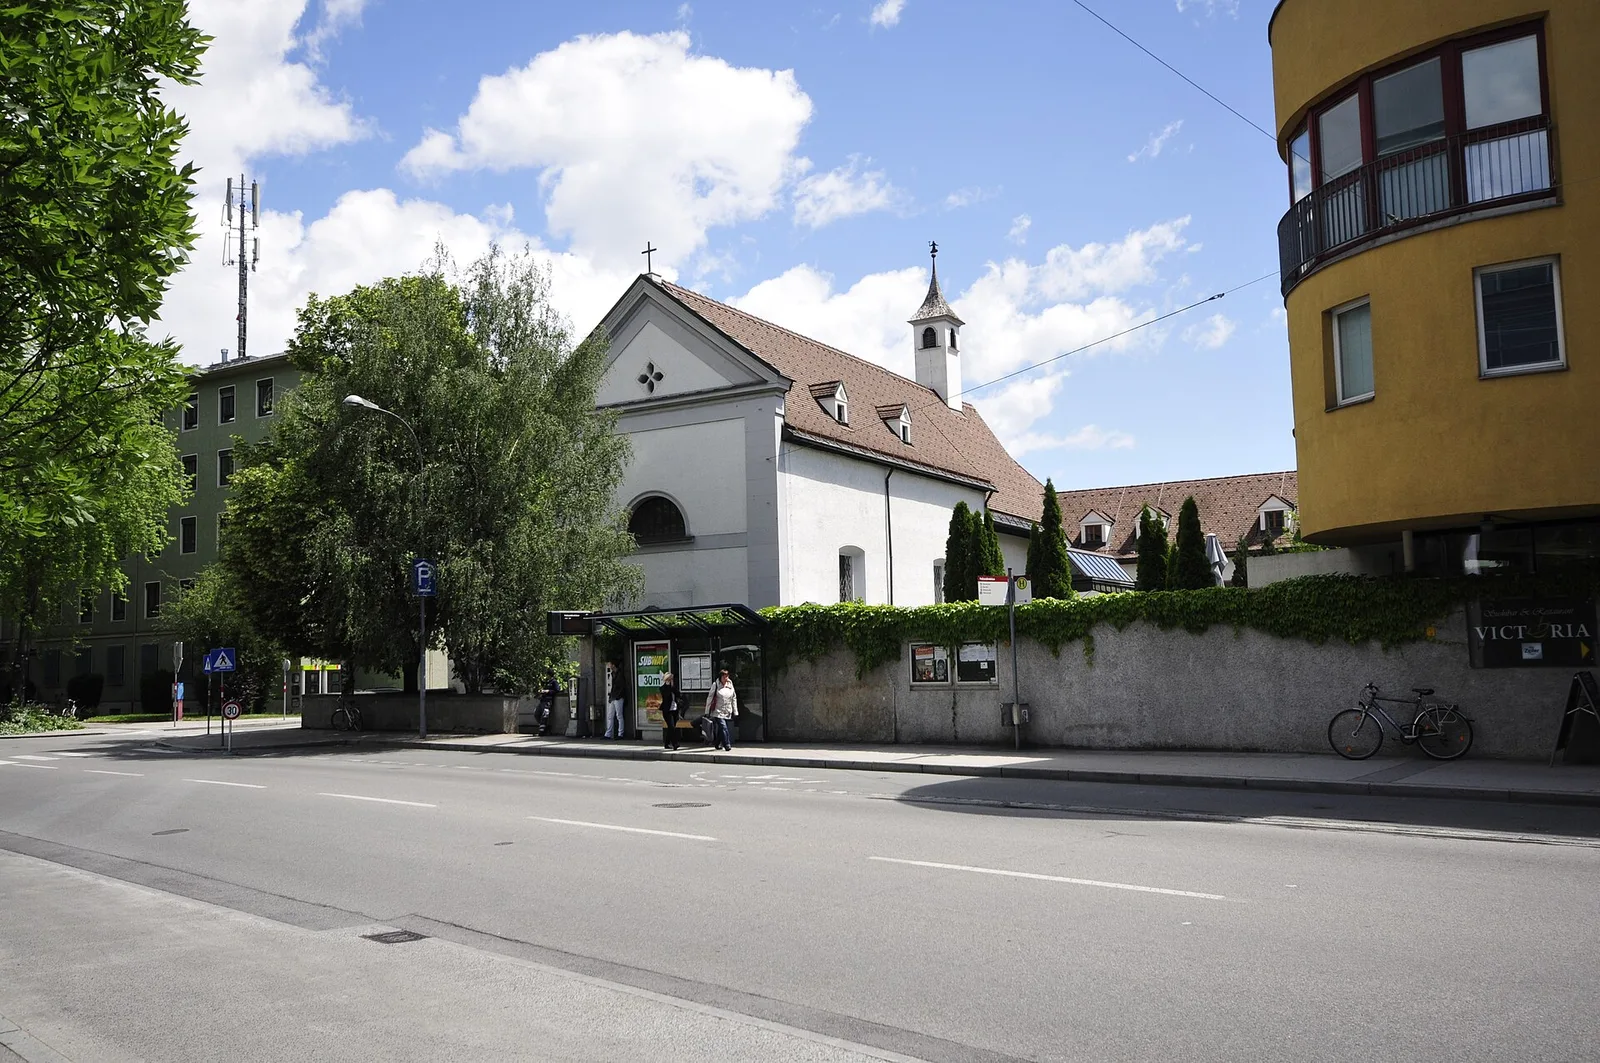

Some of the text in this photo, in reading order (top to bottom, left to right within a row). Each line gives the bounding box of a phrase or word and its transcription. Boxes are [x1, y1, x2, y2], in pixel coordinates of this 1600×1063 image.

[417, 567, 431, 586] P
[638, 655, 668, 667] SUBWAY
[226, 706, 237, 715] 30
